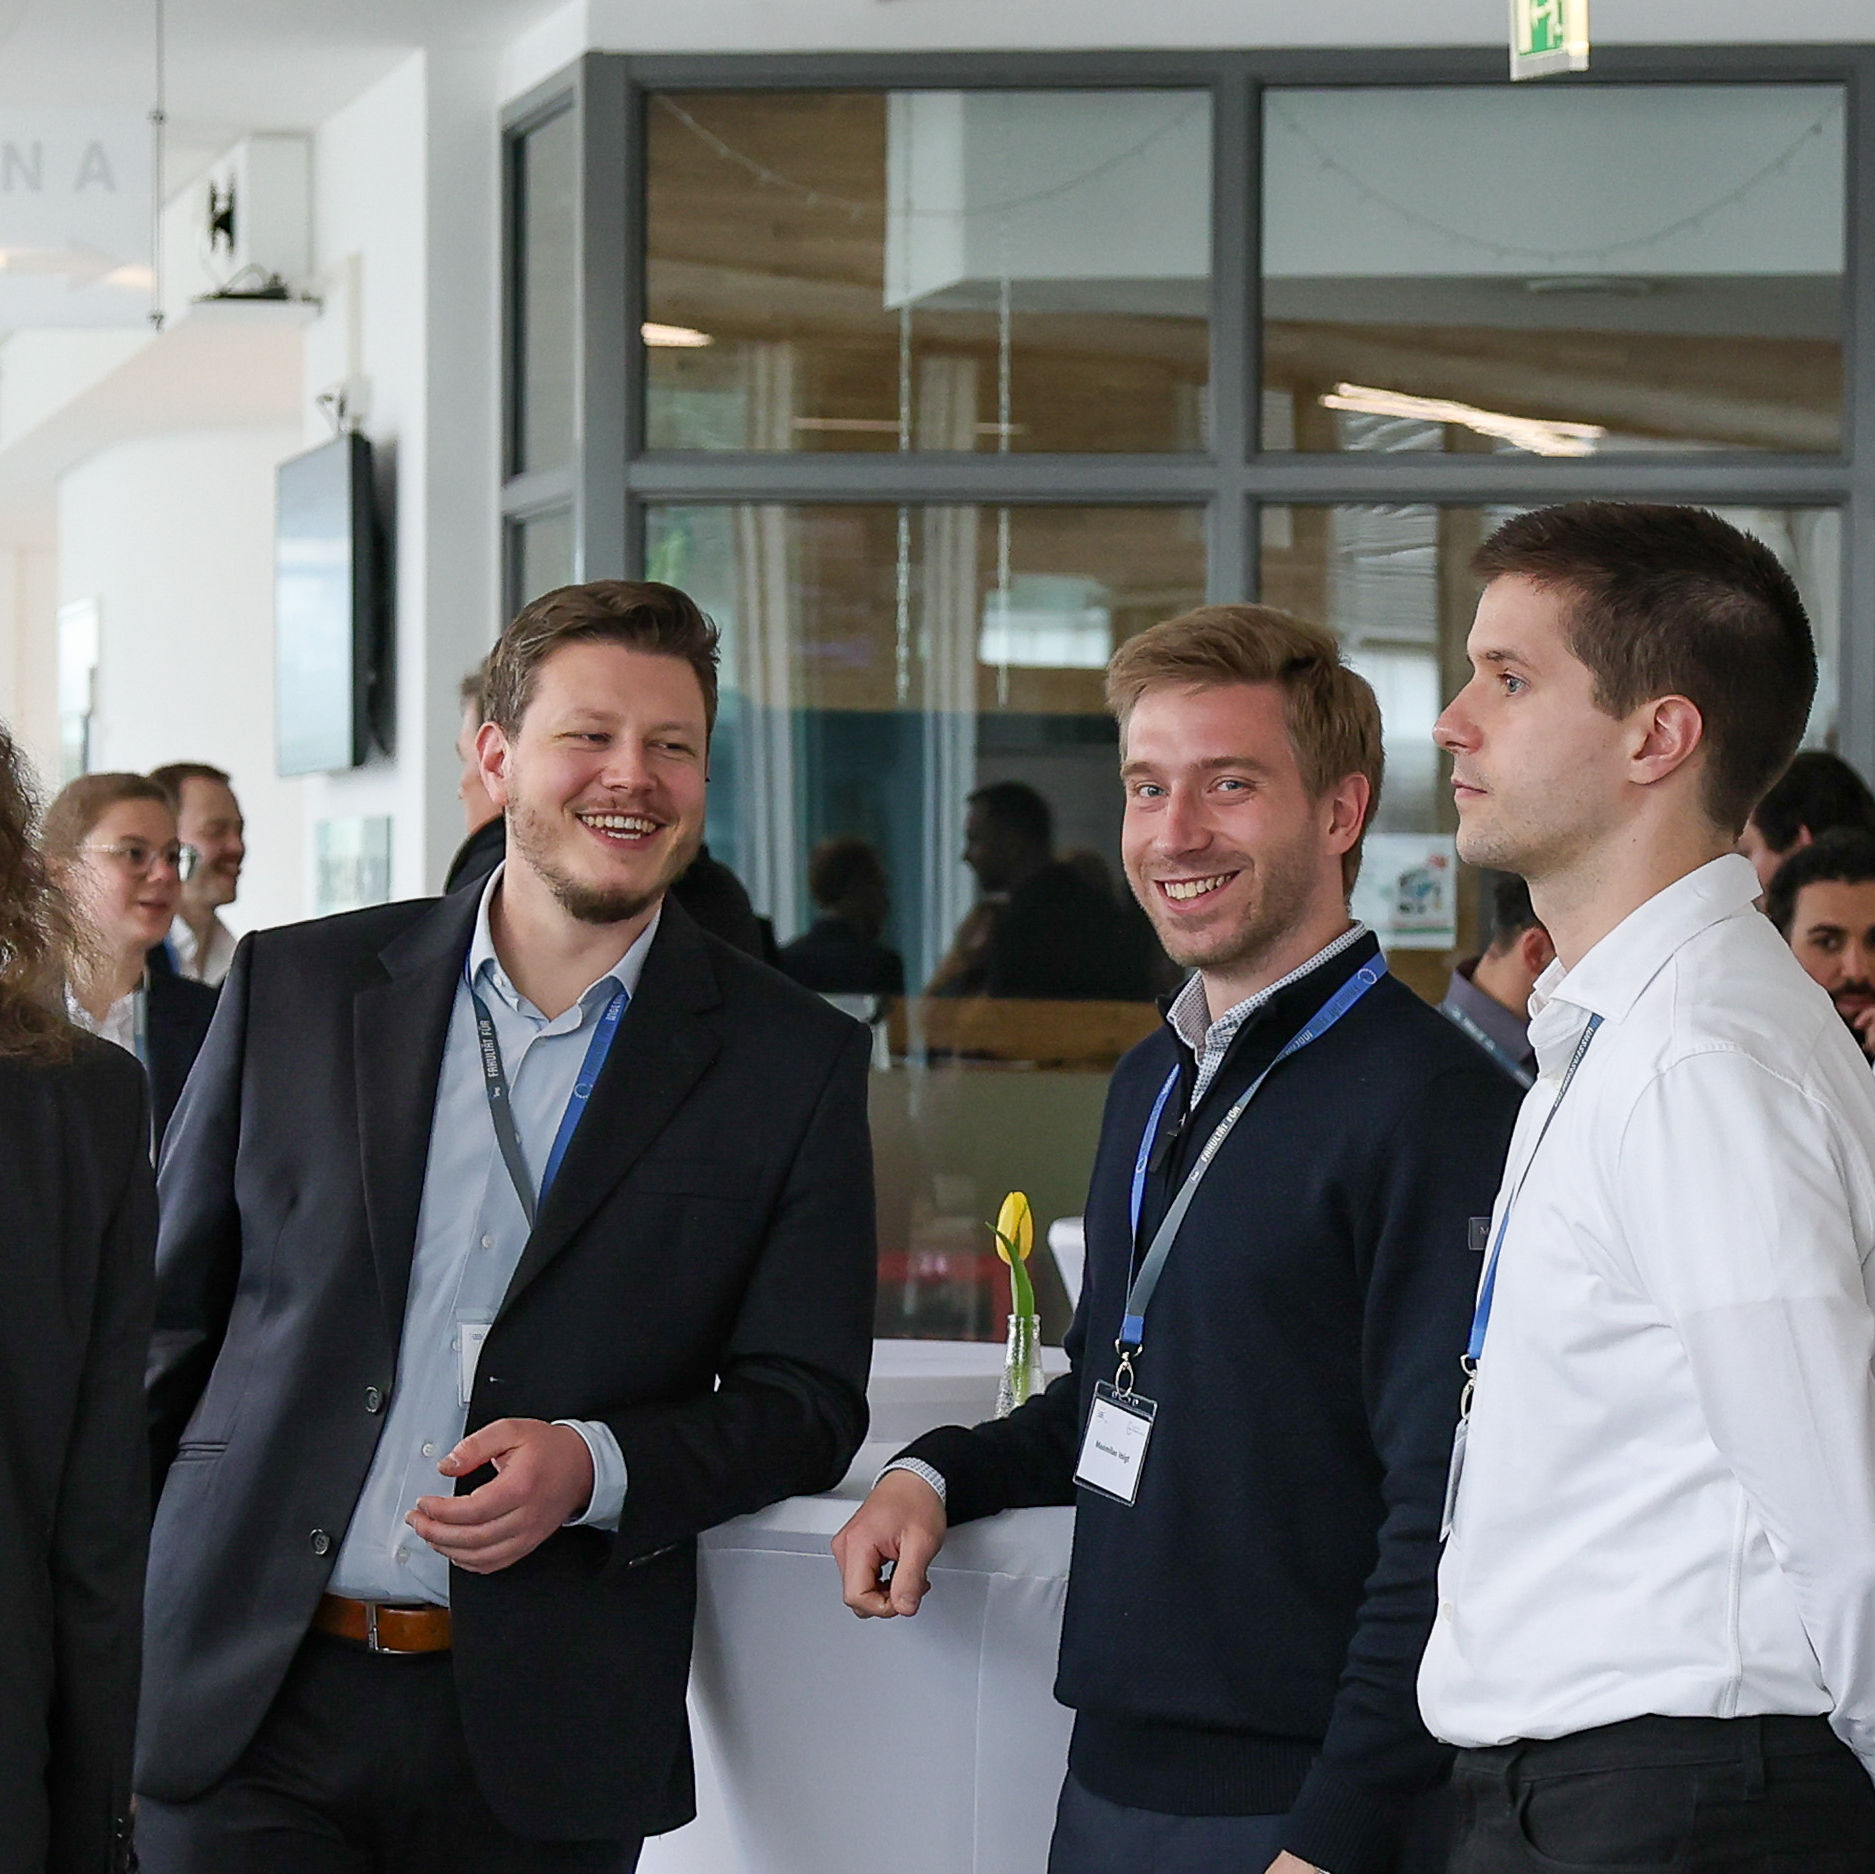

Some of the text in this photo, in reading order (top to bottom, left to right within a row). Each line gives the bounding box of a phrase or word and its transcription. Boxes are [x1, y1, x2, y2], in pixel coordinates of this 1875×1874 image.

[75, 138, 118, 194] A
[478, 1019, 500, 1078] FAKULTÄT FÜR
[1199, 1122, 1229, 1163] FAKULTÄT
